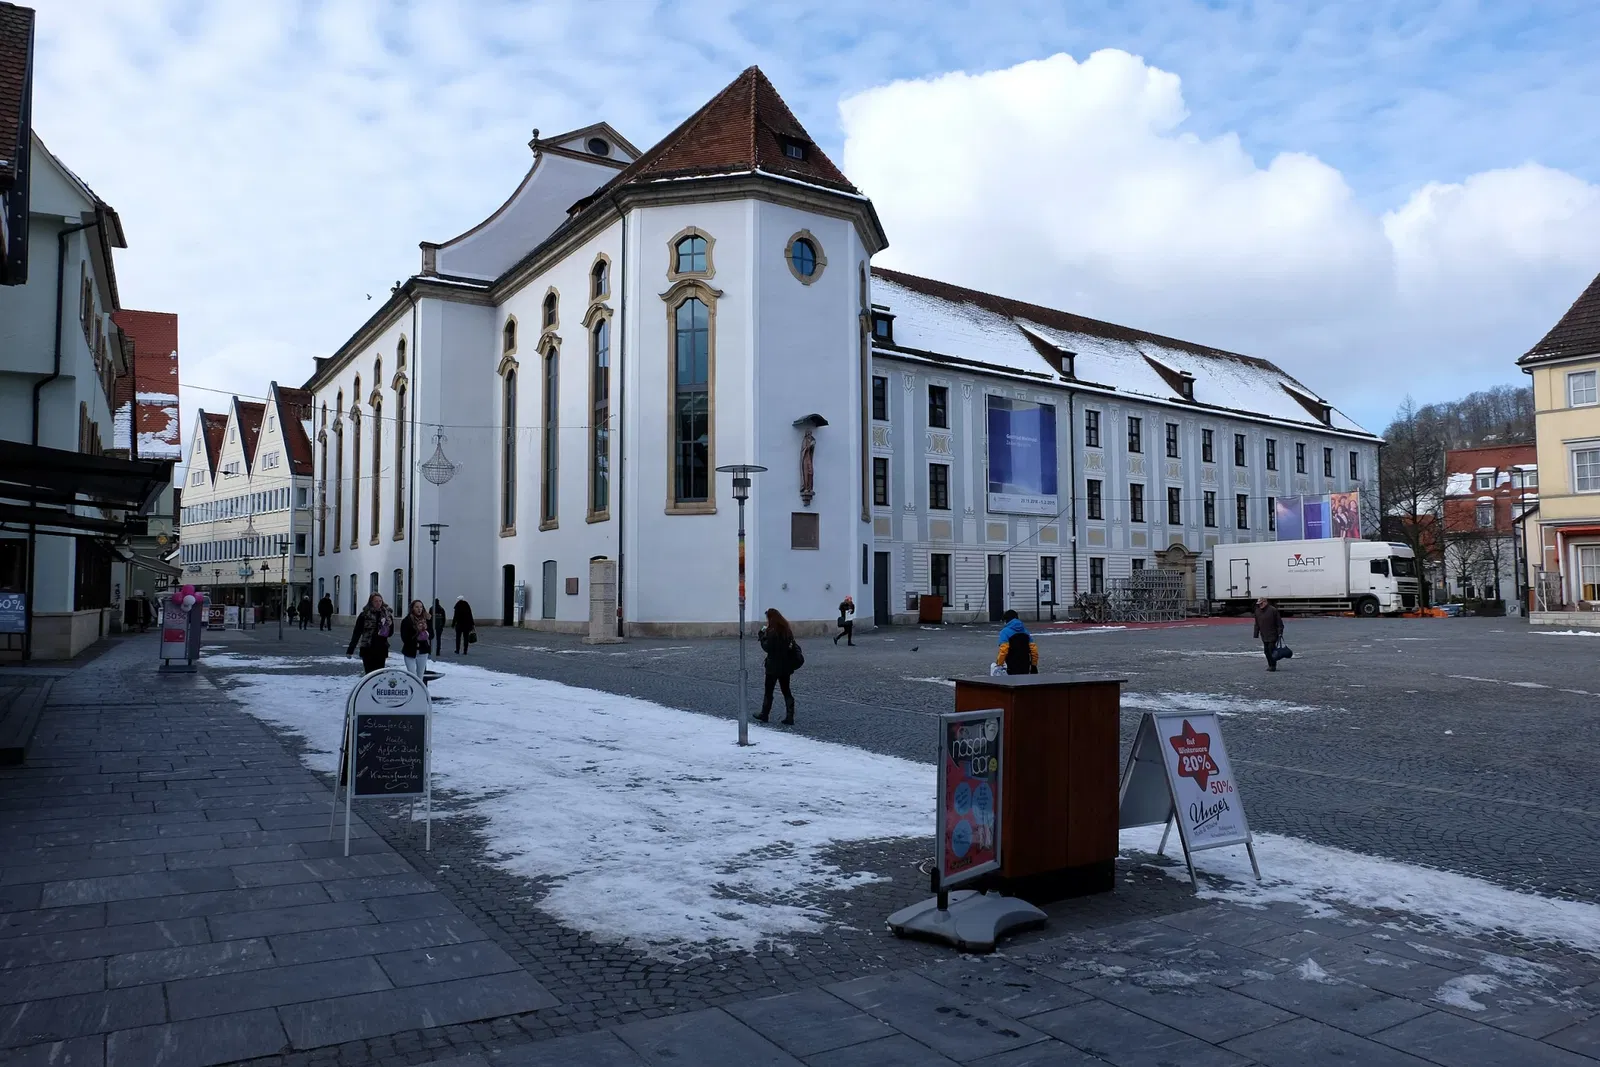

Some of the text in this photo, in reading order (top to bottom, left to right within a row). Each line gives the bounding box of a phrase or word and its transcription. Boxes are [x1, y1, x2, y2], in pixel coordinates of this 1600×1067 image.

[1288, 556, 1323, 567] DART
[376, 688, 409, 696] HEUBACHER
[1182, 754, 1211, 772] 20%
[1210, 780, 1233, 794] 50%
[1189, 798, 1230, 823] Unger
